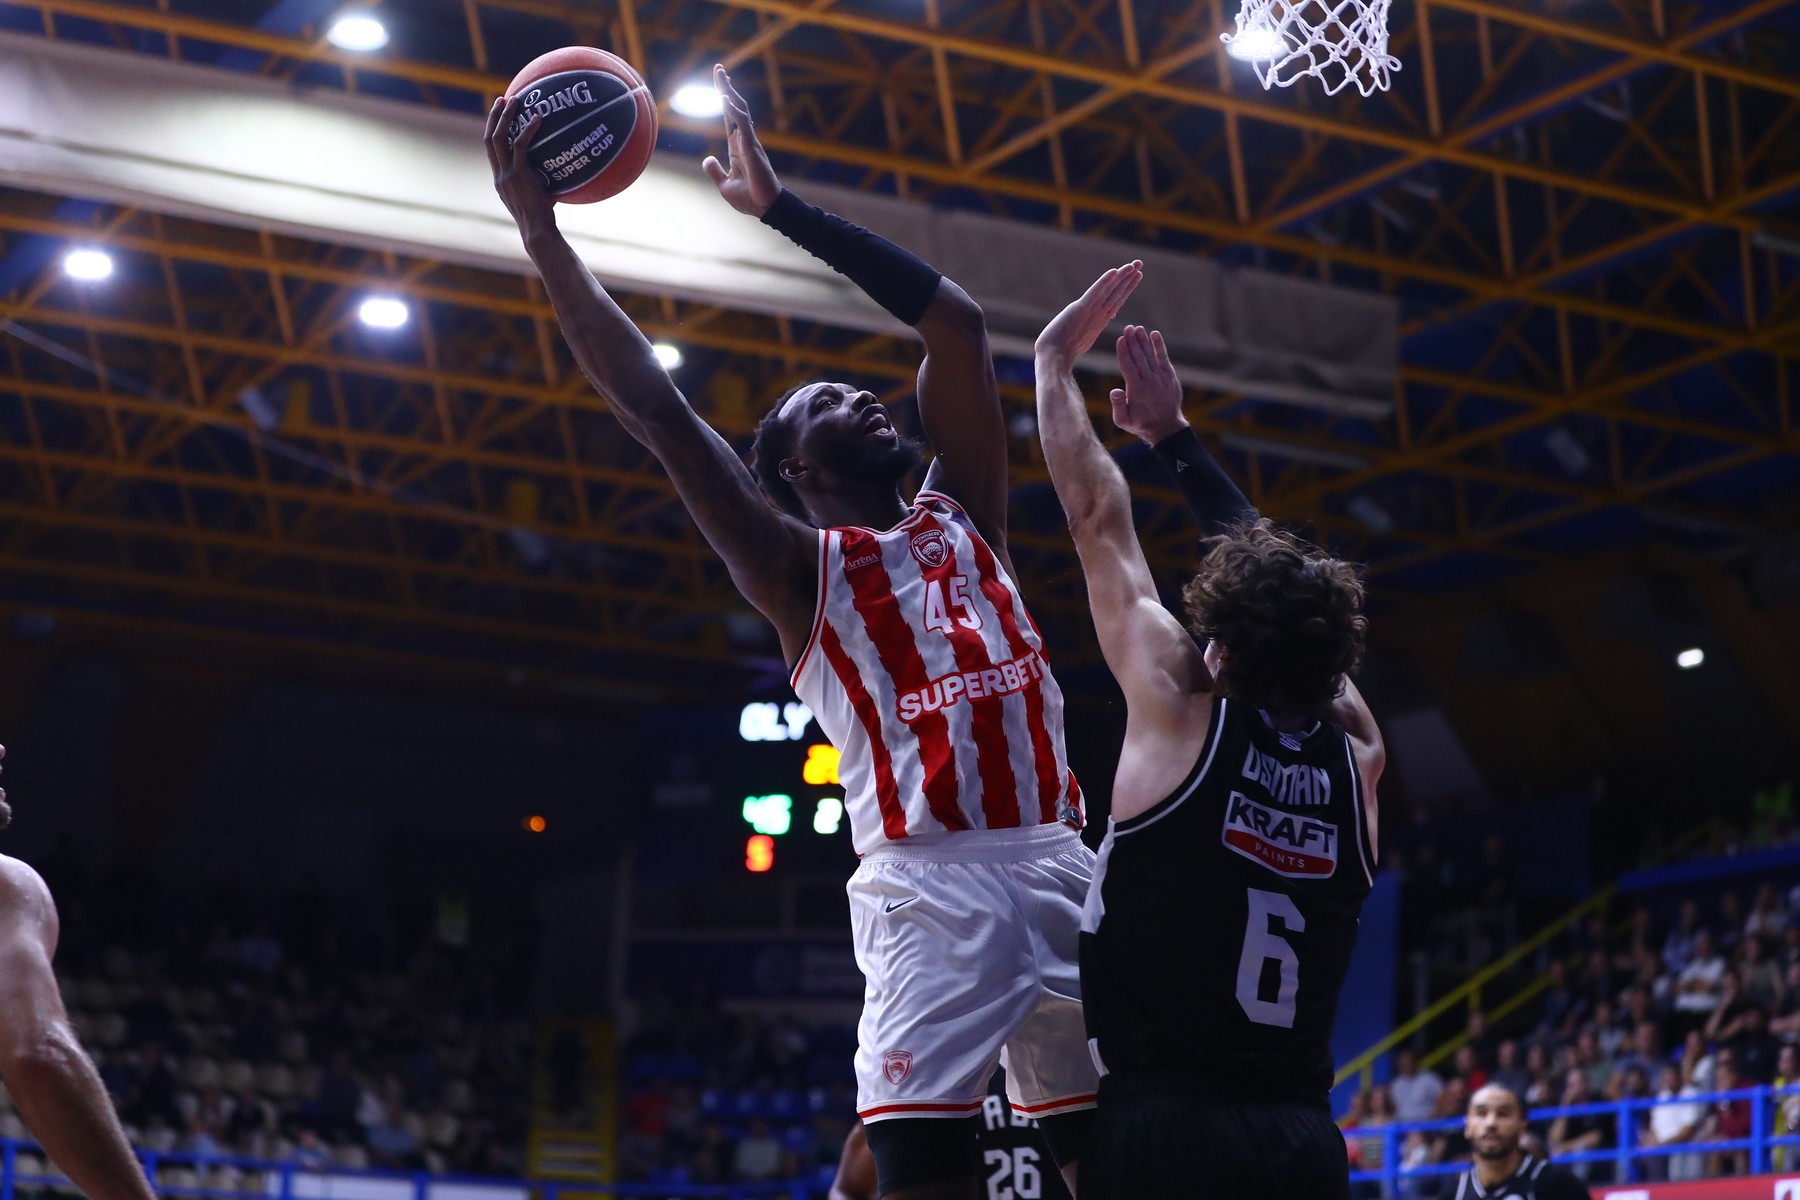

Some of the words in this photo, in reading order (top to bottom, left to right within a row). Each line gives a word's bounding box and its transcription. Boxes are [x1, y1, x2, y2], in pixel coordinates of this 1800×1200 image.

[508, 81, 593, 150] PALDING
[543, 123, 608, 172] Stoiximan
[552, 155, 592, 181] SUPER
[590, 133, 615, 157] CUP
[924, 574, 983, 633] 45
[900, 652, 1040, 721] SUPERBET
[1241, 741, 1331, 805] OSMAN
[1228, 797, 1334, 853] KRAFT
[1255, 843, 1305, 868] PAINTS
[1235, 887, 1306, 1029] 6
[983, 1147, 1041, 1200] 26
